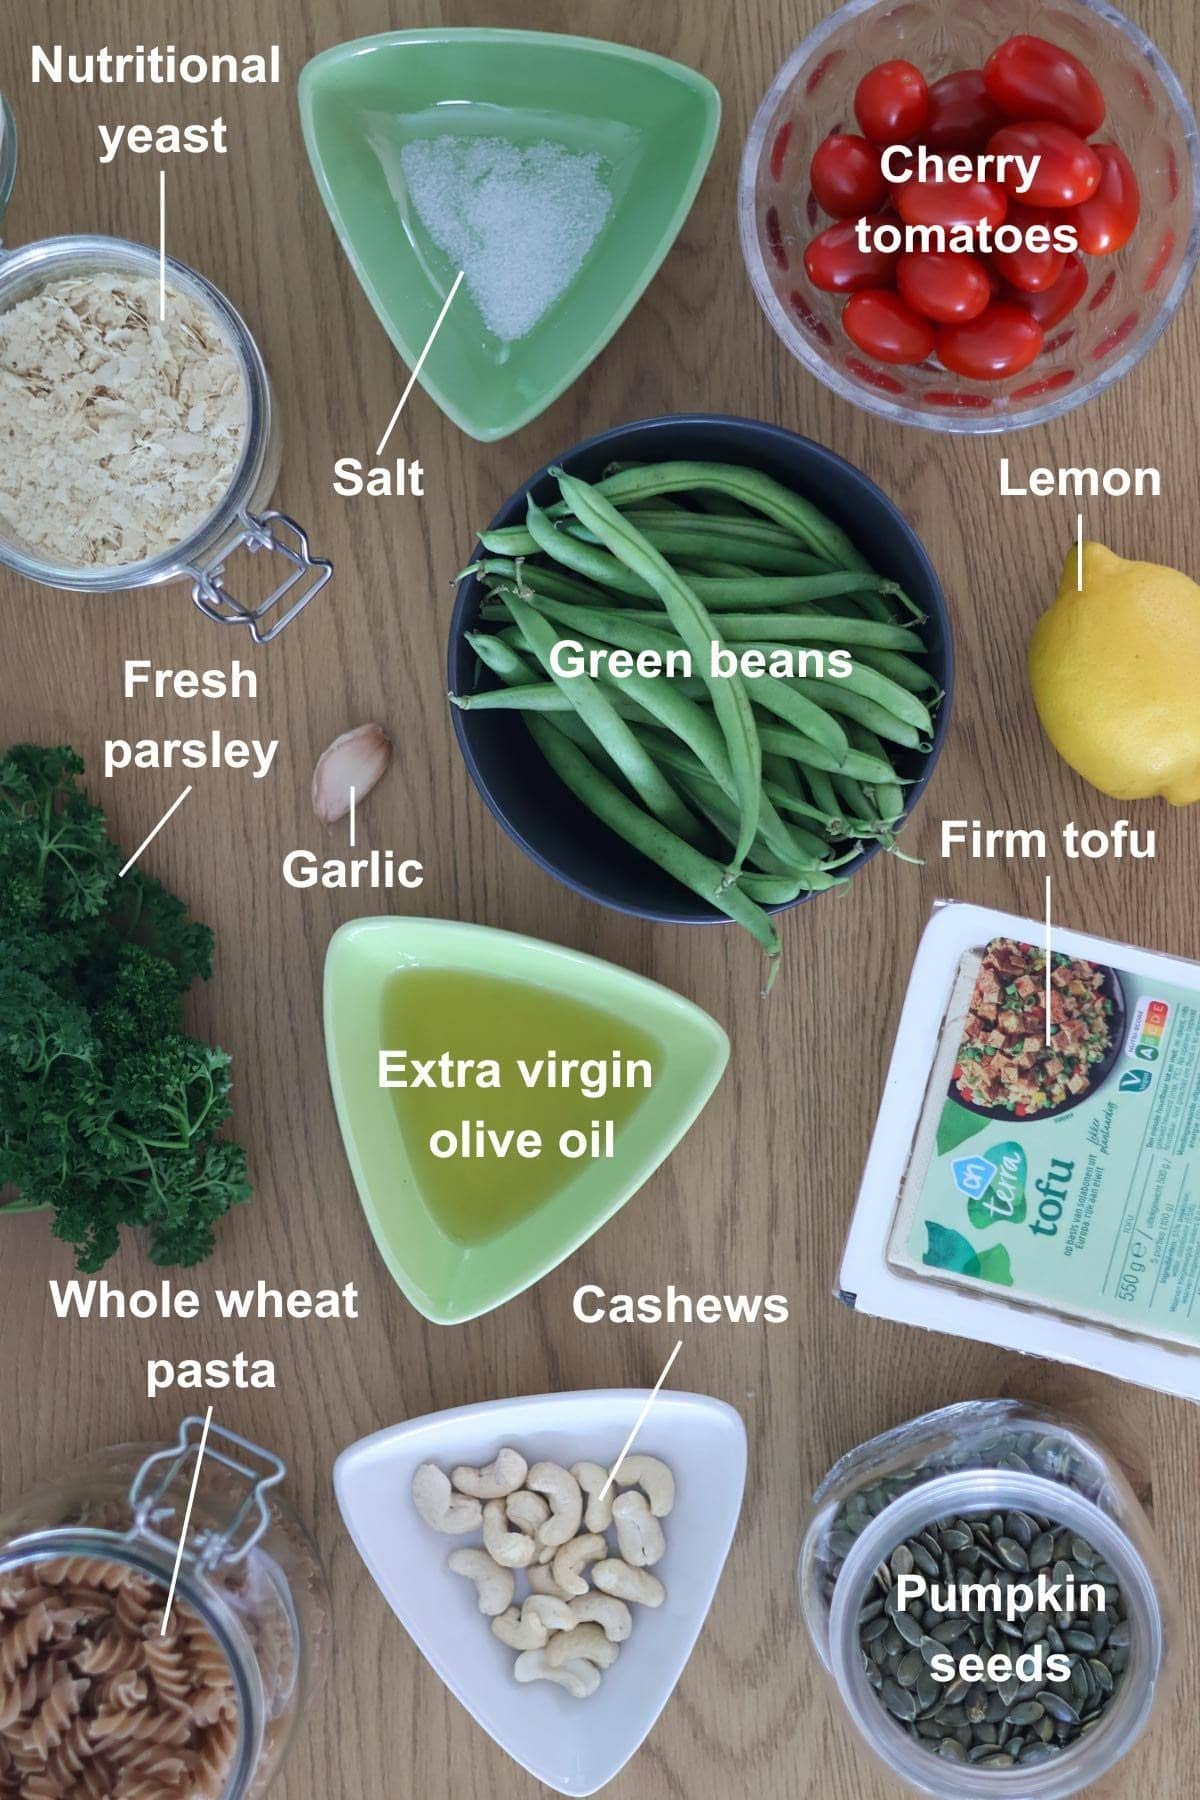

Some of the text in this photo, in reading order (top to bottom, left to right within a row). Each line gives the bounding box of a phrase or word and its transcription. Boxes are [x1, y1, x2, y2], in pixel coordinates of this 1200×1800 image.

[1141, 1045, 1155, 1059] A
[982, 1152, 1022, 1216] terra
[1028, 1159, 1075, 1237] tofu
[1074, 1208, 1083, 1224] van
[1119, 1273, 1140, 1303] 550
[1131, 1261, 1147, 1273] g
